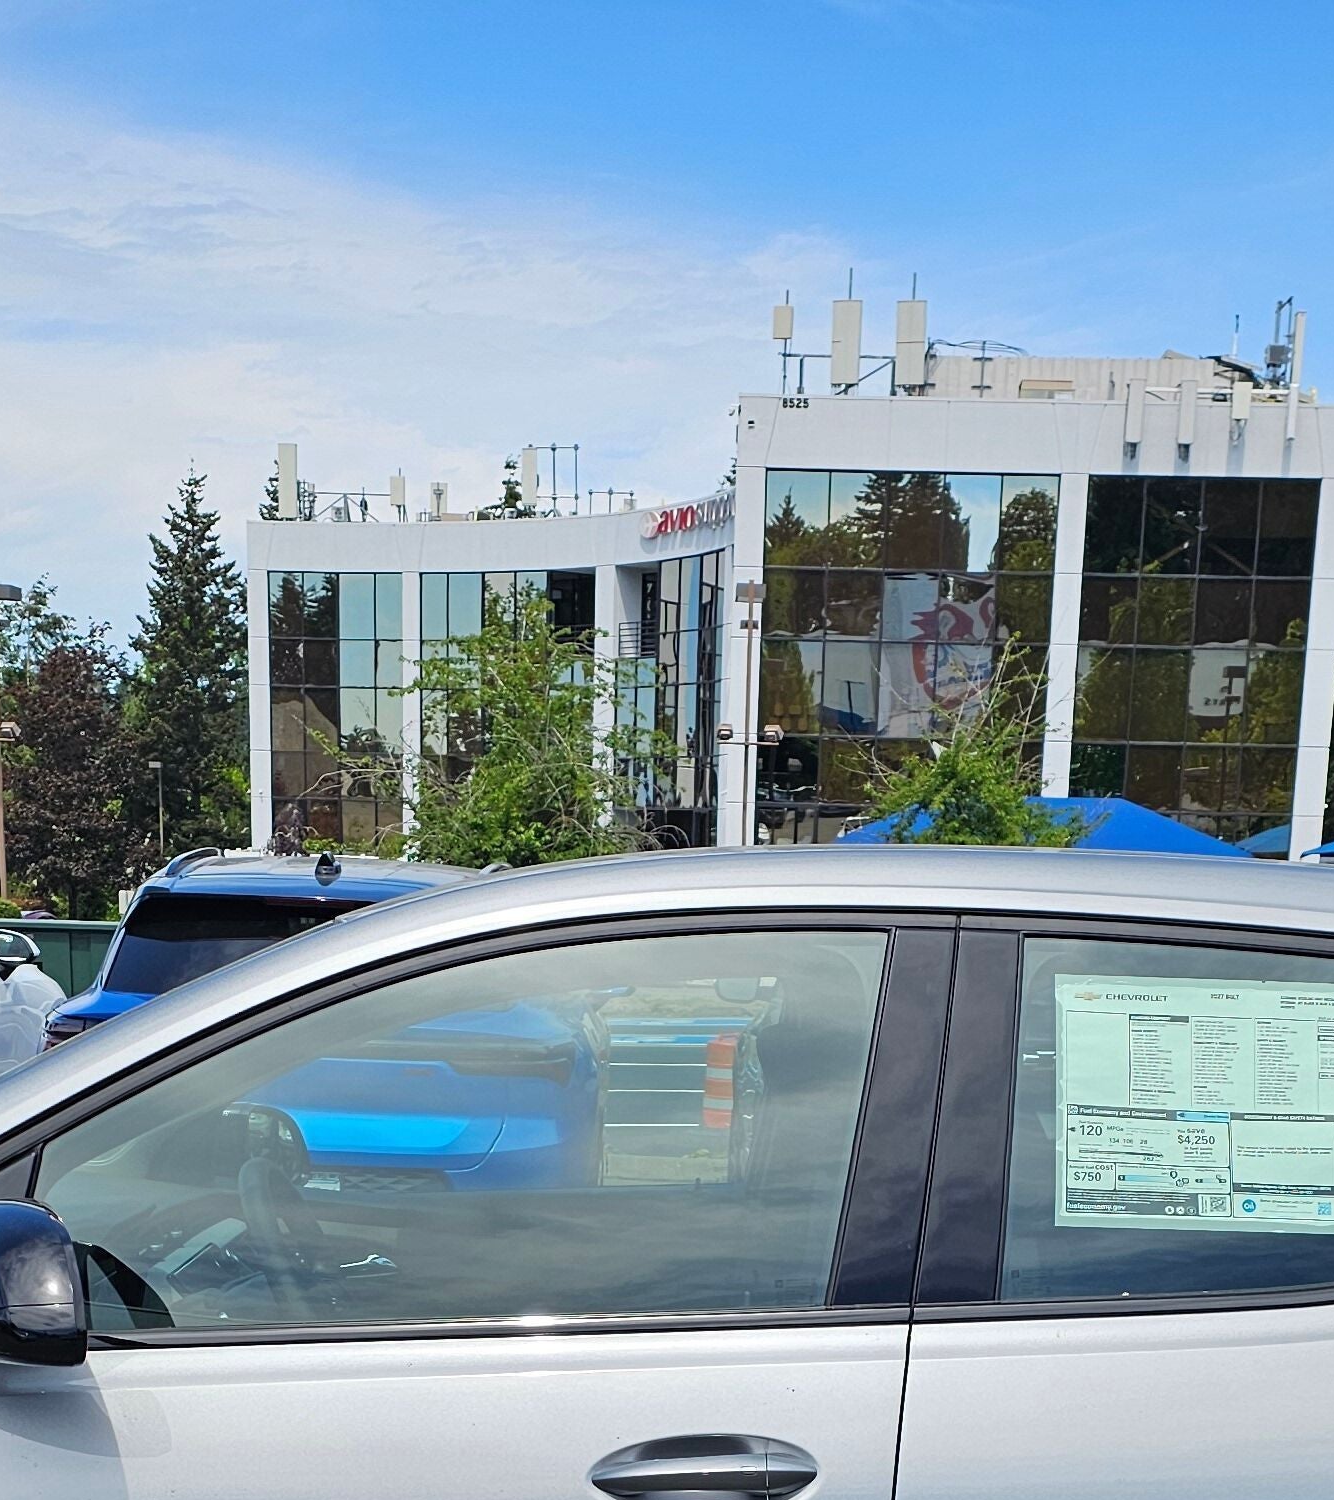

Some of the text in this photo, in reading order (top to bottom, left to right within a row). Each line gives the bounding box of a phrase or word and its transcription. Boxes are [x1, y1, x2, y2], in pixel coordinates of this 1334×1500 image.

[783, 398, 809, 408] 8525
[1105, 993, 1168, 1002] CHEVROLET
[1079, 1125, 1103, 1136] 120
[1177, 1135, 1216, 1145] $4,250
[1073, 1171, 1102, 1181] $750
